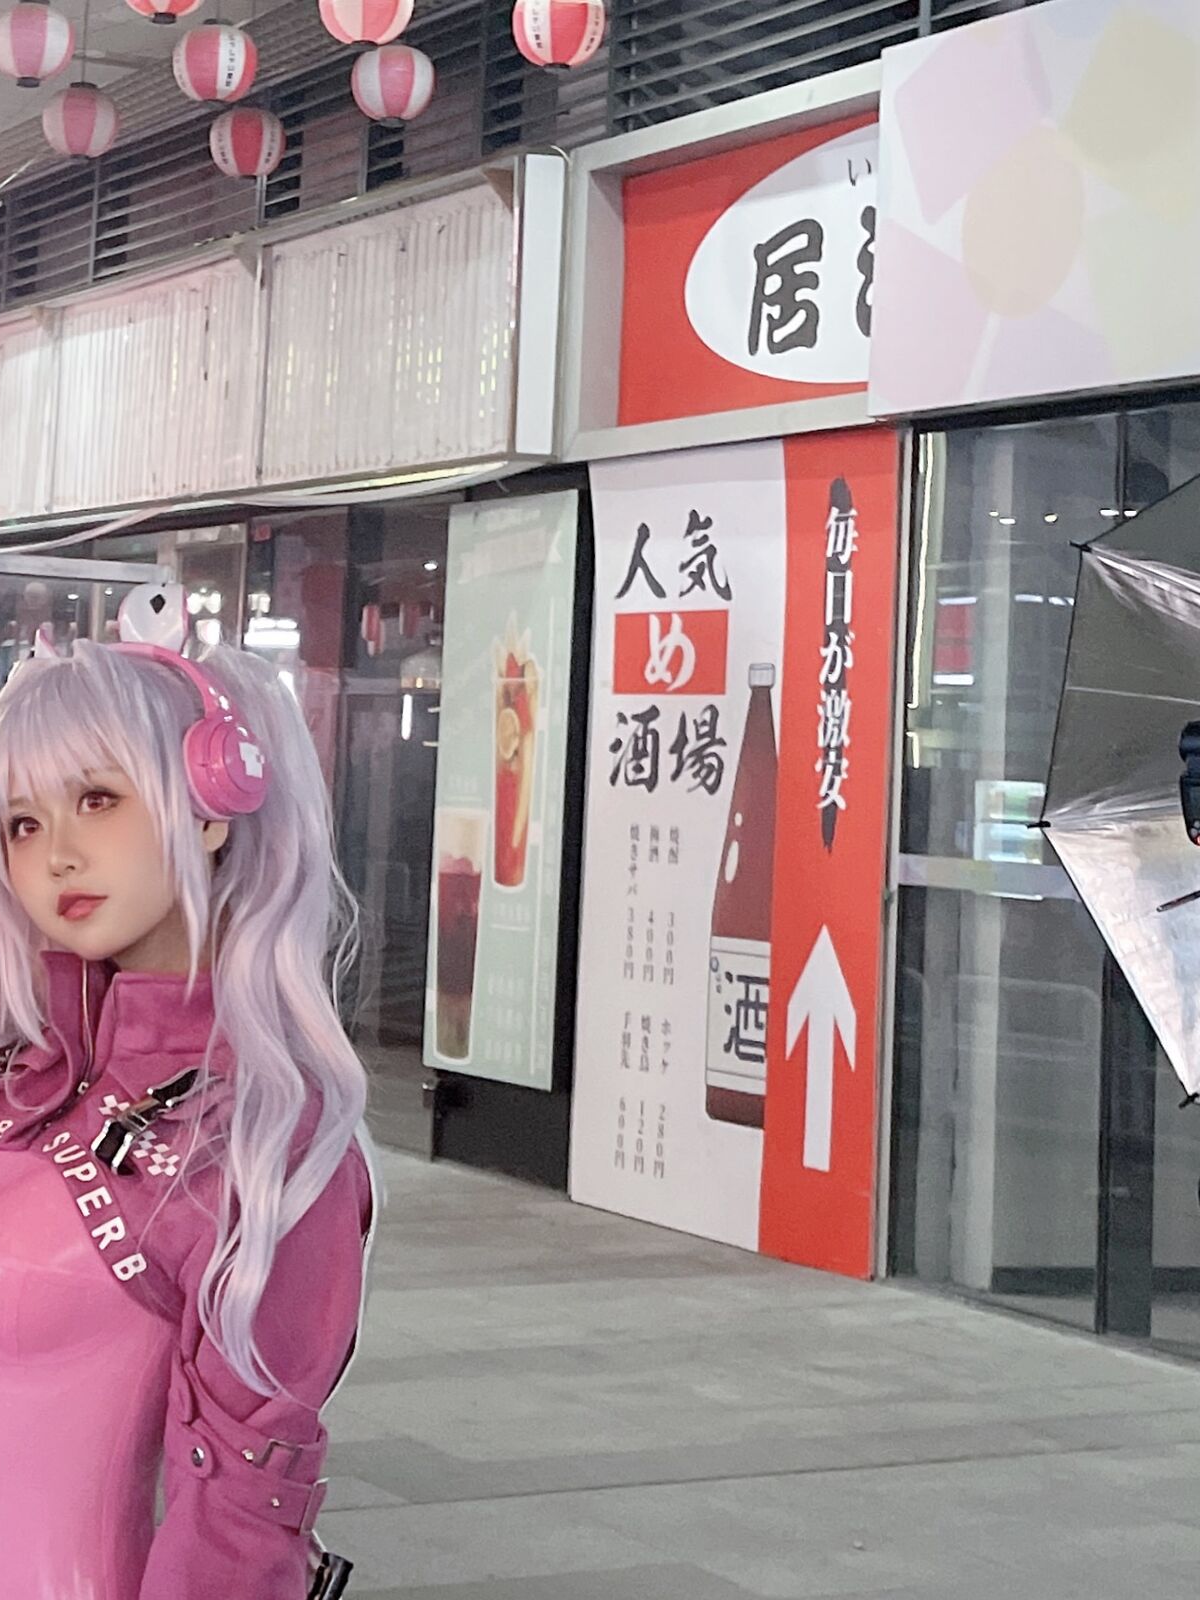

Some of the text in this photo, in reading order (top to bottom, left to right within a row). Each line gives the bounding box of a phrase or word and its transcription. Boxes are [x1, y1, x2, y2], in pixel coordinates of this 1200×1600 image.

[614, 509, 732, 601] 人気
[644, 612, 696, 692] め
[815, 506, 859, 810] 毎日が激安
[609, 704, 727, 796] 酒場
[723, 970, 770, 1064] 酒
[633, 1100, 645, 1174] 120円
[42, 1131, 148, 1282] SUPERB
